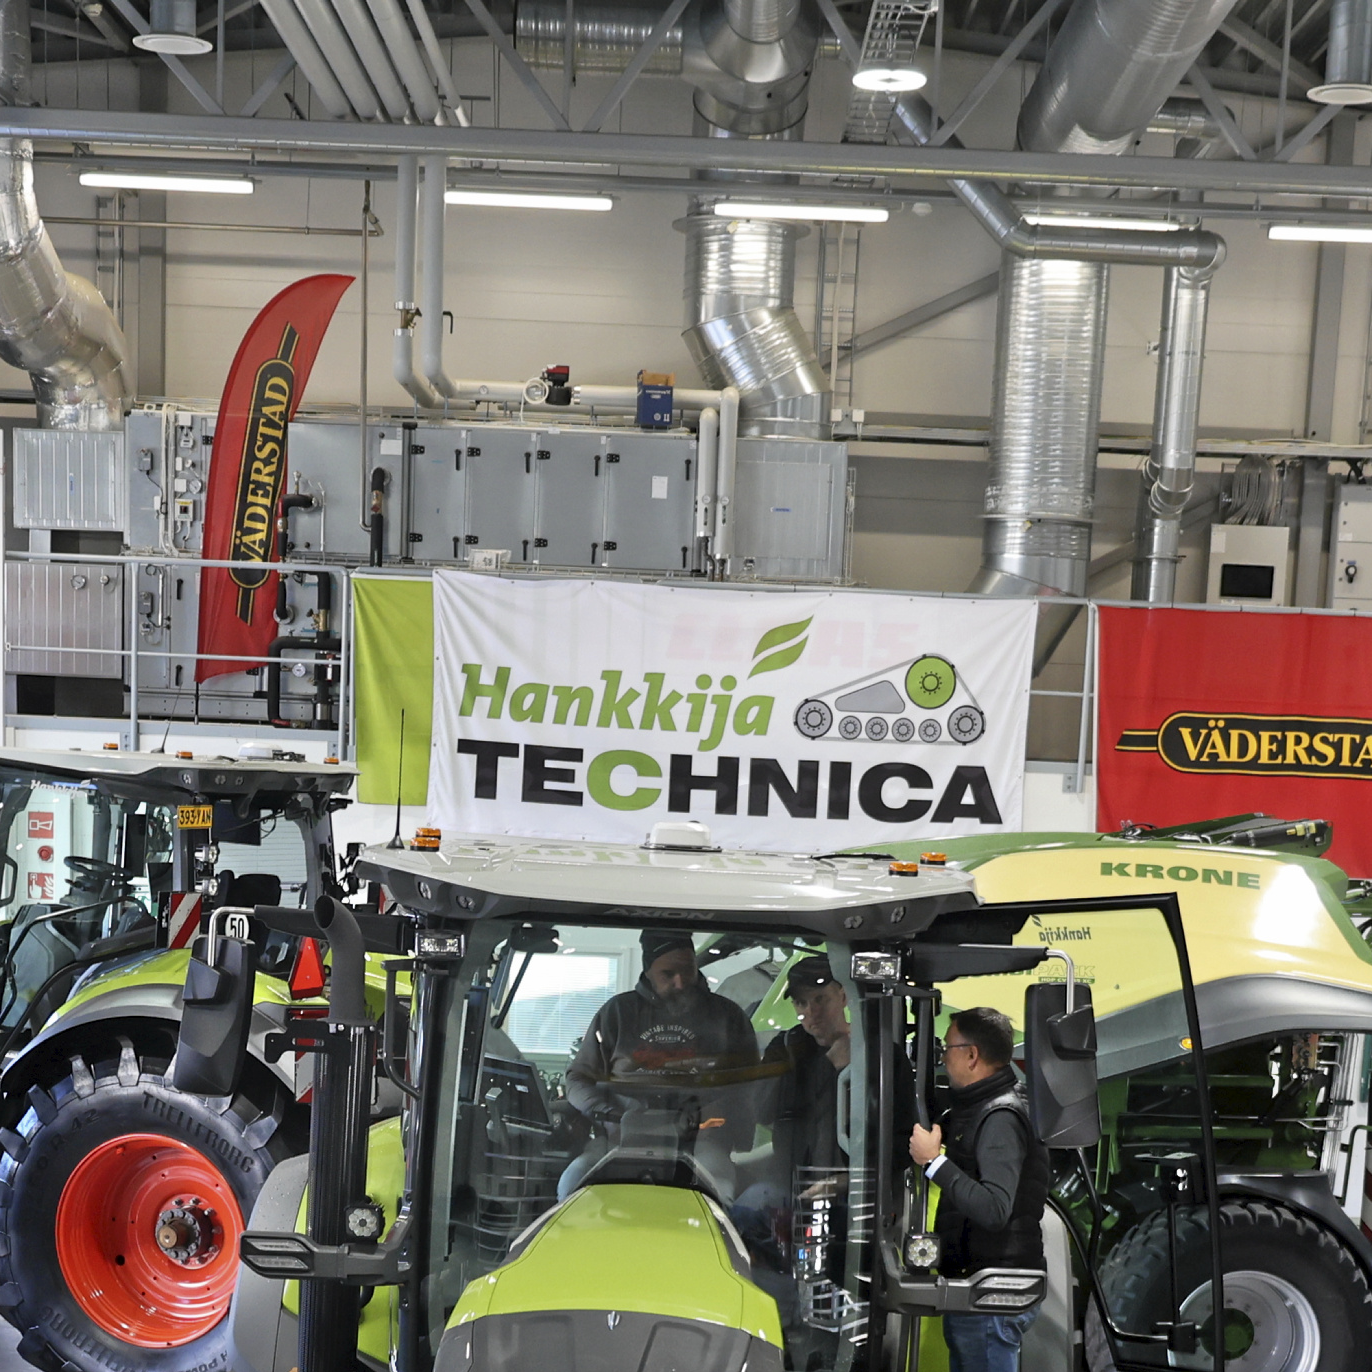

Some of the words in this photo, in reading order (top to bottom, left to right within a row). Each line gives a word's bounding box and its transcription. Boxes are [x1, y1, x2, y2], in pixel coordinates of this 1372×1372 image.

[238, 376, 290, 568] VÄDERSTAD
[458, 662, 775, 752] Hankkija
[457, 738, 1002, 824] TECHNICA
[1100, 862, 1260, 889] KRONE
[230, 917, 244, 939] 50
[603, 907, 715, 920] AXION
